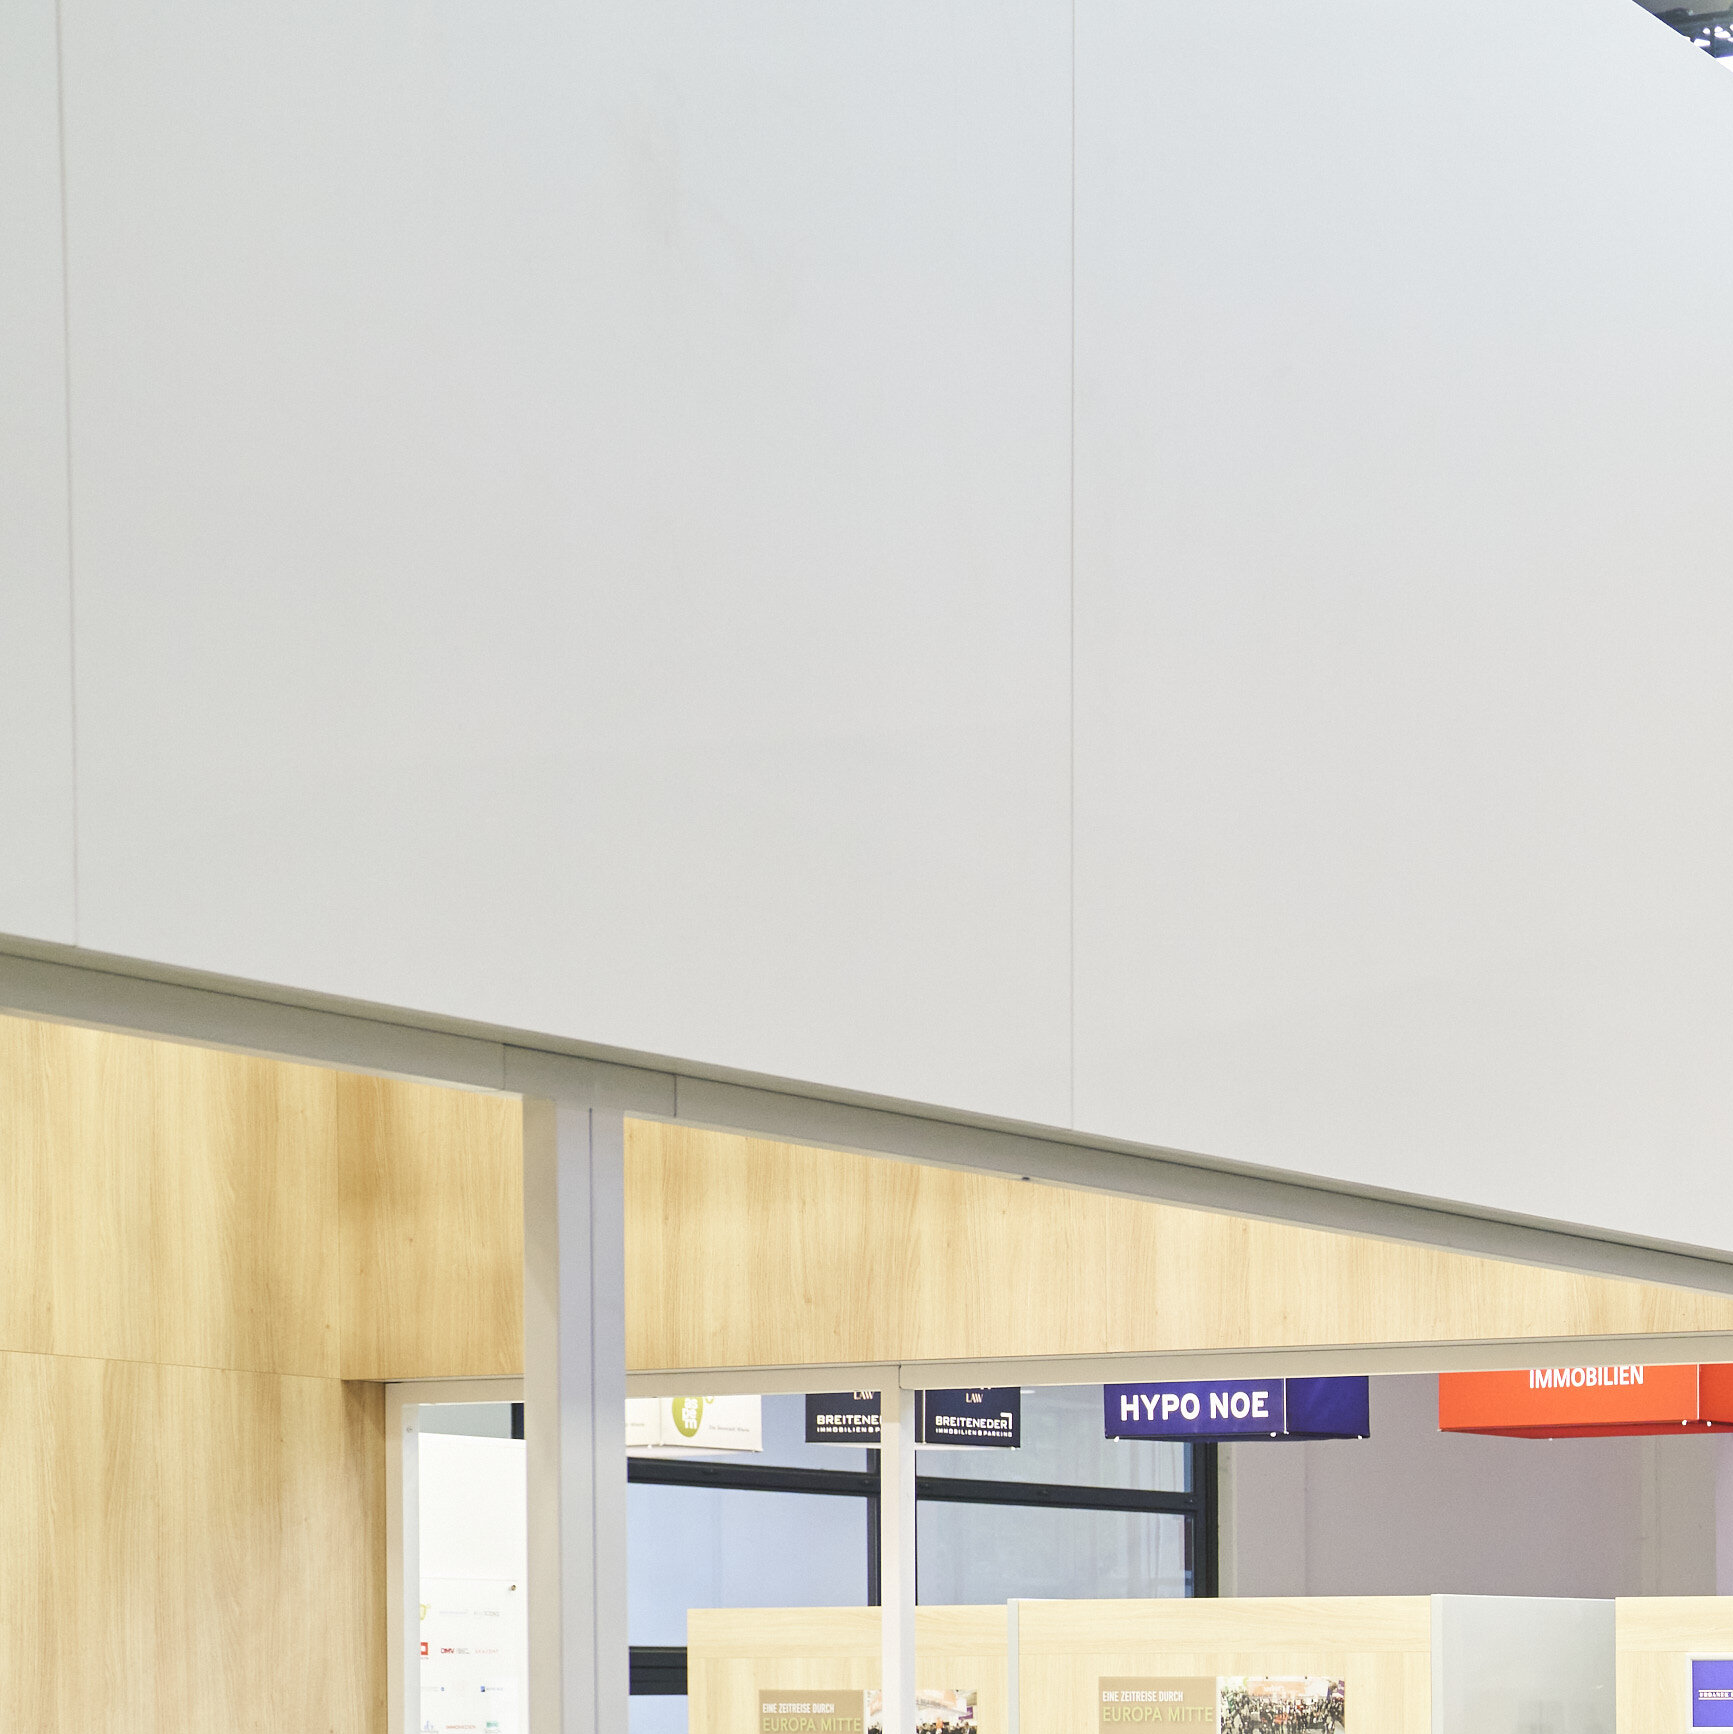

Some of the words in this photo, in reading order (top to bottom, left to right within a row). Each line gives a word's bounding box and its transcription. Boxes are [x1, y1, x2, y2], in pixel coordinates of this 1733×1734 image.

[1529, 1366, 1644, 1390] IMMOBILIEN
[1120, 1392, 1200, 1422] HYPO
[1209, 1390, 1269, 1419] NOE
[816, 1414, 881, 1425] BREITENE
[935, 1415, 1009, 1430] BREITENEDER
[1102, 1691, 1119, 1702] EINE
[1120, 1690, 1157, 1702] ZEITREISE
[1158, 1690, 1184, 1702] DURCH
[762, 1703, 778, 1714] EINE
[778, 1703, 811, 1714] ZEITREISE
[1102, 1706, 1161, 1722] EUROPA
[1168, 1707, 1214, 1722] MITTE
[762, 1717, 816, 1732] EUROPA
[821, 1717, 862, 1732] MITTE
